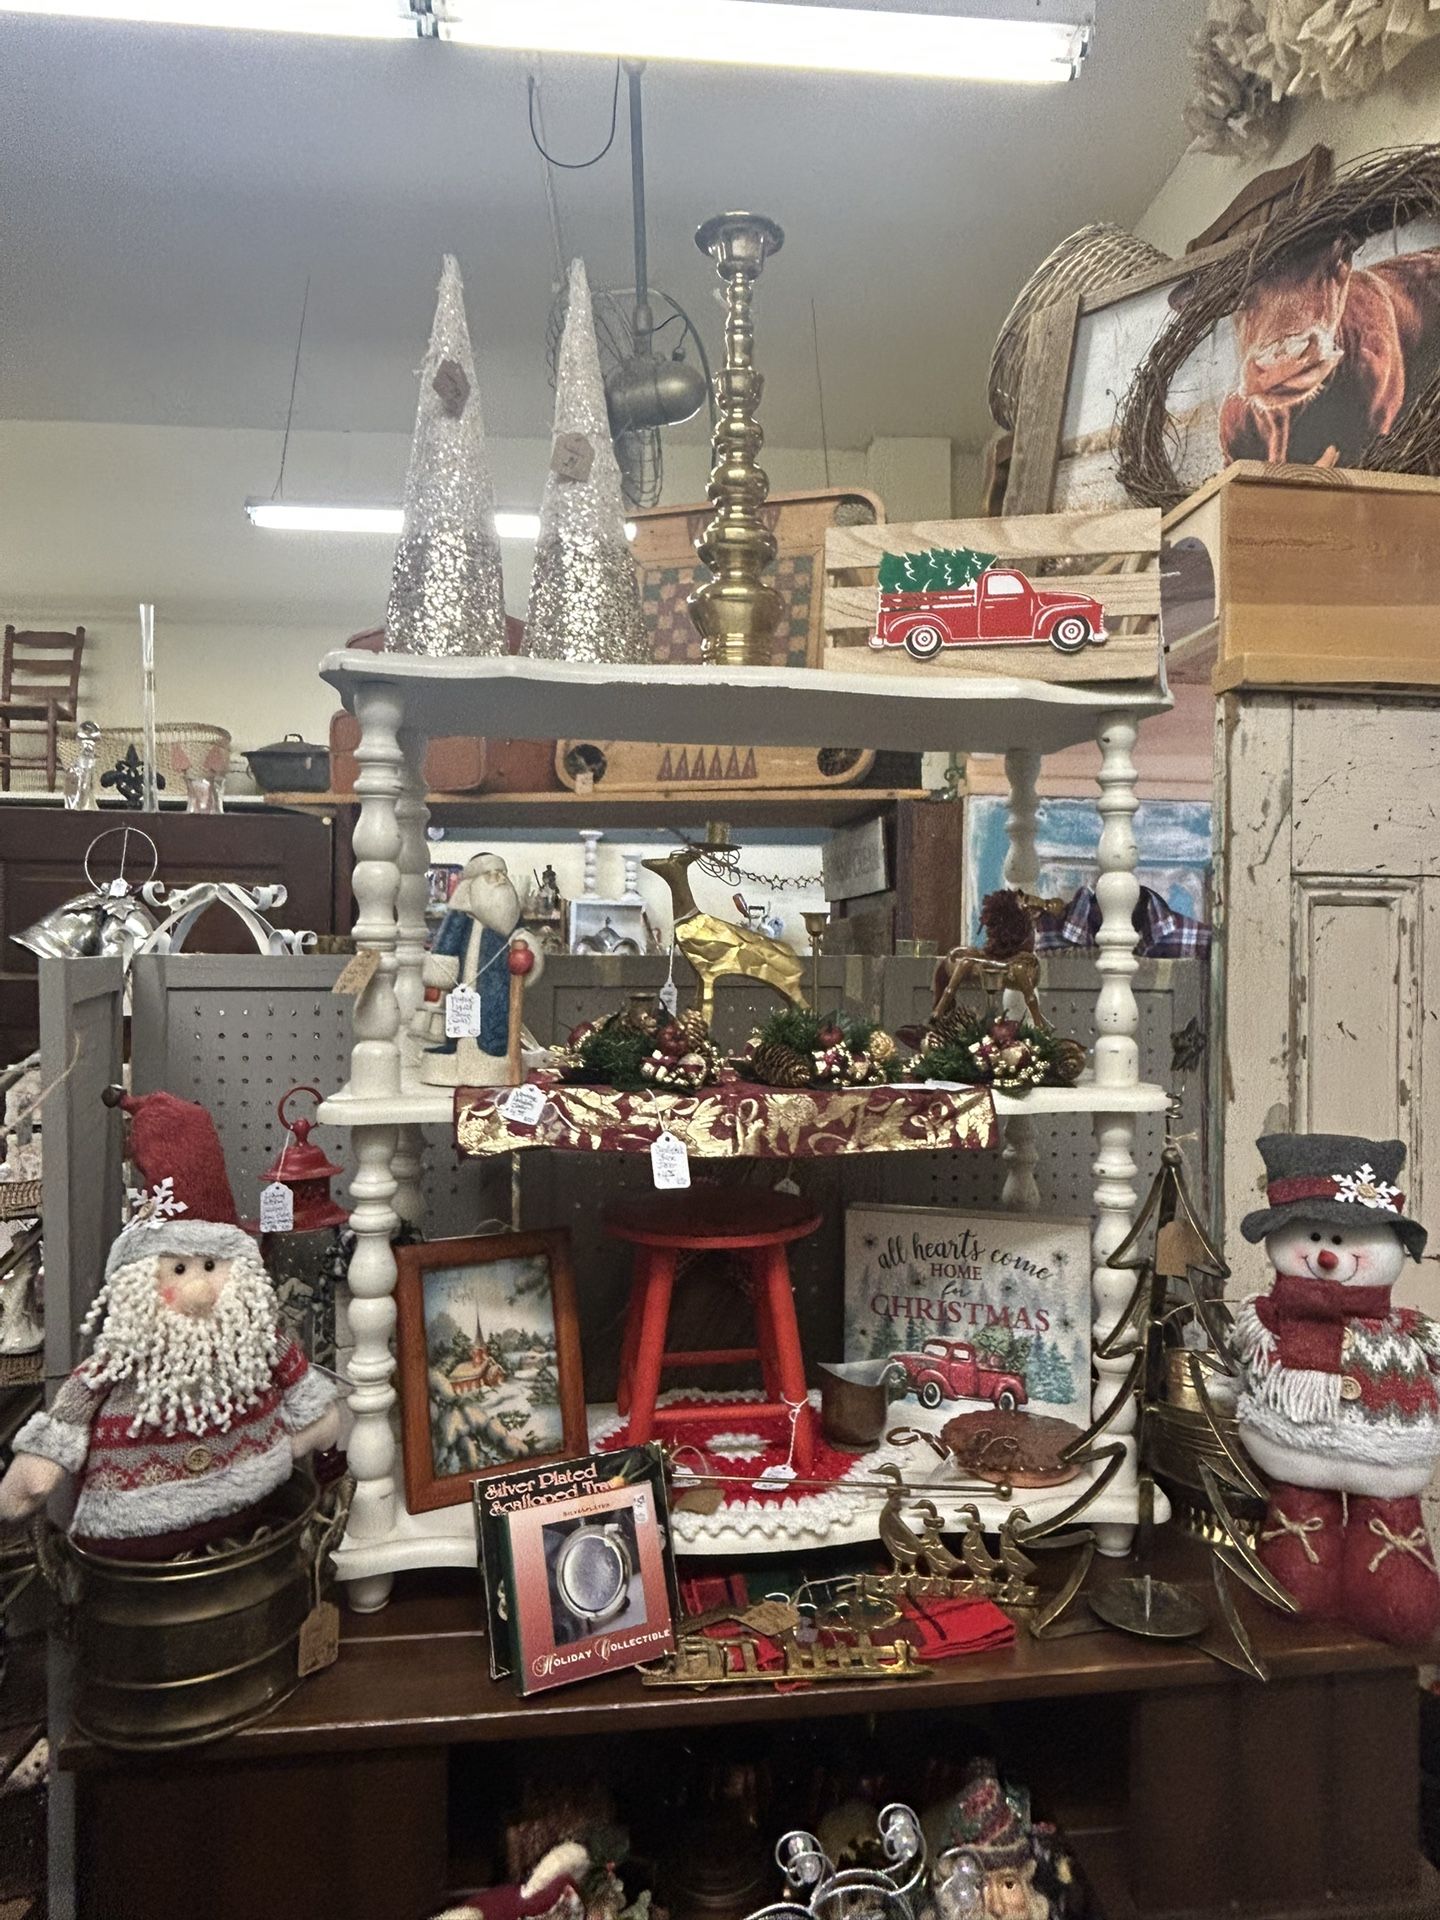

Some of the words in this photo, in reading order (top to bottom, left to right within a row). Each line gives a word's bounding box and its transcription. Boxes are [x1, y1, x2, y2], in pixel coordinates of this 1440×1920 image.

[878, 1236, 907, 1270] all
[912, 1228, 986, 1262] hearts
[990, 1247, 1053, 1281] come
[931, 1263, 982, 1281] HOME
[941, 1280, 971, 1301] for
[870, 1293, 1050, 1332] CHRISTMAS
[484, 1480, 536, 1500] Silver
[538, 1462, 598, 1489] Plated
[532, 1649, 592, 1678] HOLIDAY
[594, 1628, 671, 1664] COLLECTIBLE
